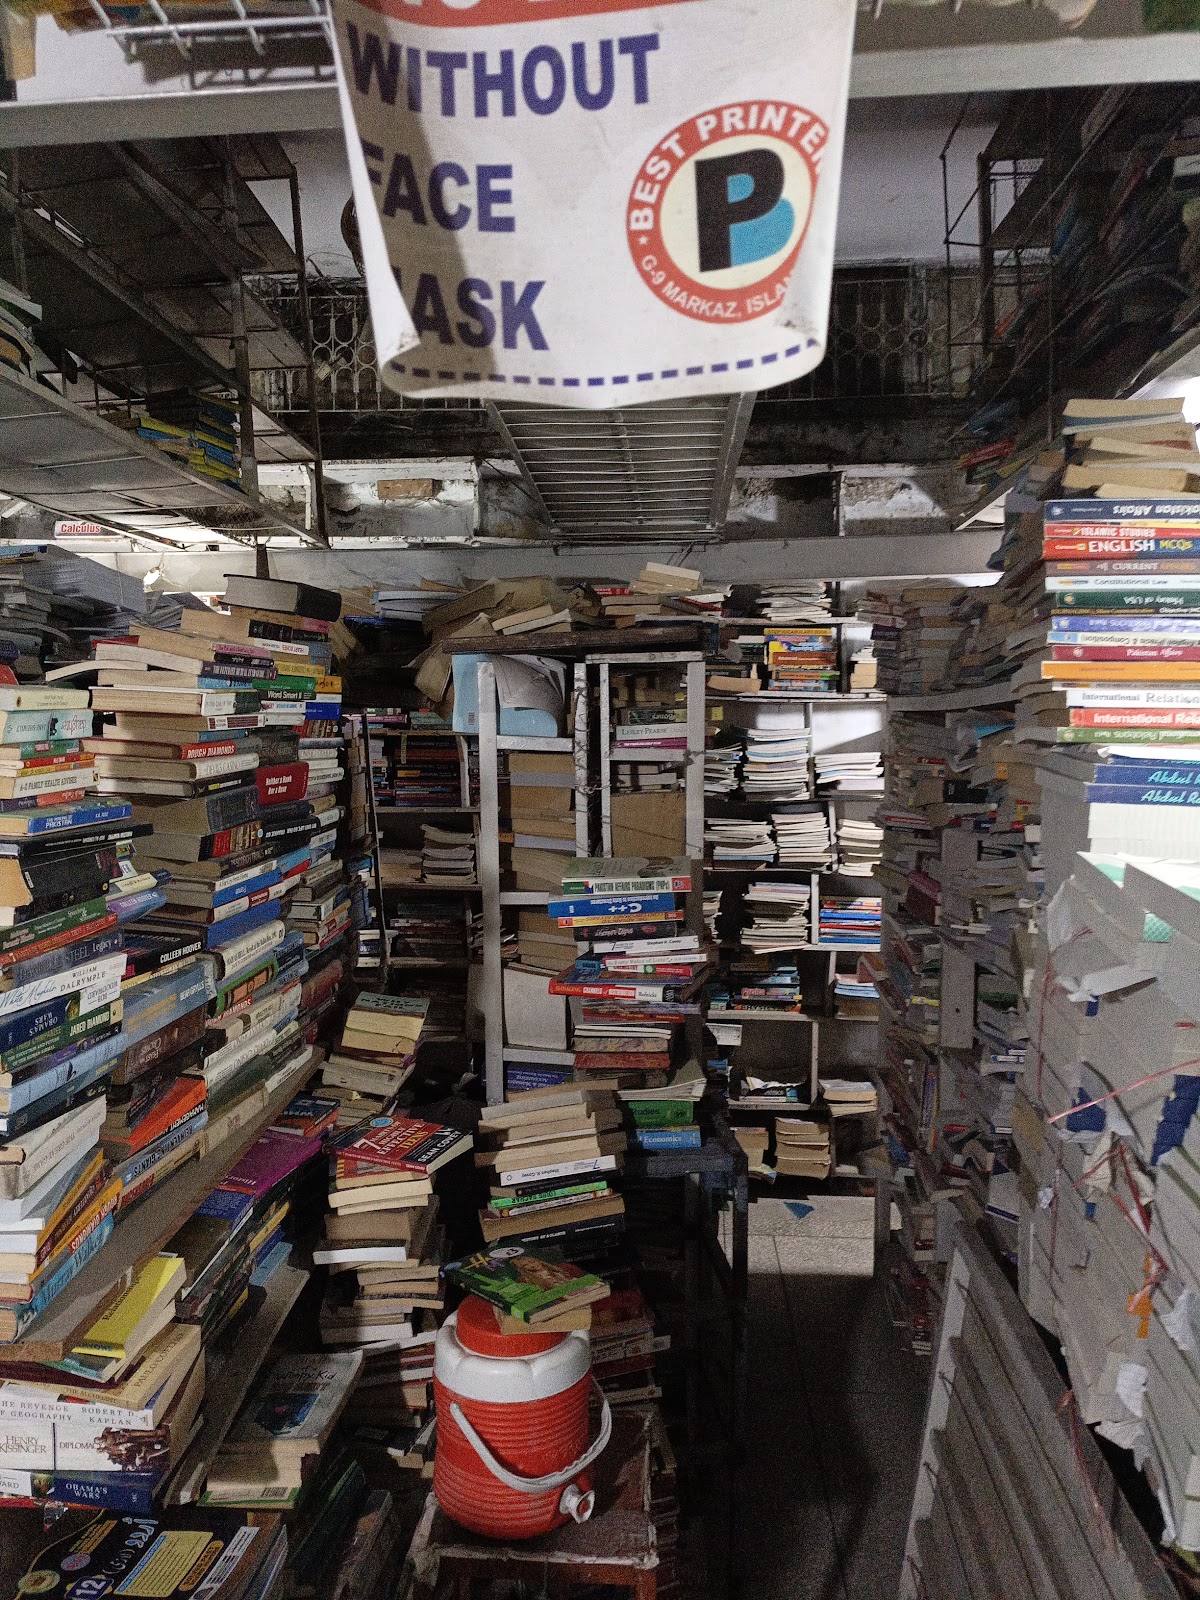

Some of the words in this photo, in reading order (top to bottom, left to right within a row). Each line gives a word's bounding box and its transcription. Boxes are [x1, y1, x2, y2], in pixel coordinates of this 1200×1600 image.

[346, 23, 660, 117] WITHOUT
[630, 132, 686, 231] BEST
[391, 263, 549, 351] ASK
[1112, 505, 1154, 516] Affairs
[60, 523, 101, 533] Calculus
[1081, 527, 1118, 537] ISLAMIC
[1119, 527, 1156, 538] STUDIES
[1088, 540, 1156, 553] ENGLISH
[1123, 596, 1144, 605] USA
[267, 690, 282, 699] Word
[282, 690, 298, 699] Smart
[1081, 692, 1140, 702] International
[60, 714, 87, 736] daughter
[1093, 713, 1173, 724] International
[1174, 713, 1200, 724] Rela
[187, 747, 206, 759] ROUGH
[206, 745, 235, 757] DIAMONDS
[1147, 770, 1190, 785] Abdul
[1140, 790, 1186, 803] Abdul
[45, 818, 73, 829] PAKISTAN
[608, 902, 643, 913] C++
[92, 939, 112, 953] Legacy
[160, 949, 182, 964] COLLEEN
[181, 941, 202, 956] HOOVER
[72, 966, 98, 978] WILLIAM
[60, 971, 106, 992] DALRYMPLE
[34, 1011, 53, 1024] WARS
[69, 1021, 87, 1037] JARED
[86, 1011, 110, 1030] DIAMOND
[28, 1016, 58, 1037] OBAMA'S
[170, 1103, 204, 1132] MANAGEMENT
[634, 1107, 660, 1116] tudies
[354, 1138, 382, 1151] 7
[377, 1122, 426, 1155] EFFECTIVE
[643, 1135, 682, 1143] Economics
[417, 1145, 439, 1163] SEAN
[437, 1130, 462, 1149] COVEY
[133, 1152, 156, 1178] GIANTS
[70, 1214, 101, 1254] DIAMONDS
[102, 1275, 142, 1321] Relationships
[133, 1363, 156, 1388] PAULO
[155, 1332, 184, 1364] COELHO
[316, 1370, 338, 1380] Kid
[0, 1401, 16, 1409] HE
[20, 1401, 70, 1412] REVENGE
[81, 1406, 123, 1416] ROBERT
[10, 1411, 73, 1422] GEOGRAPHY
[89, 1417, 133, 1426] KAPLAN
[5, 1435, 40, 1446] HENRY
[65, 1482, 108, 1495] OBAMA'S
[73, 1490, 101, 1500] WARS
[75, 1579, 107, 1596] 12
